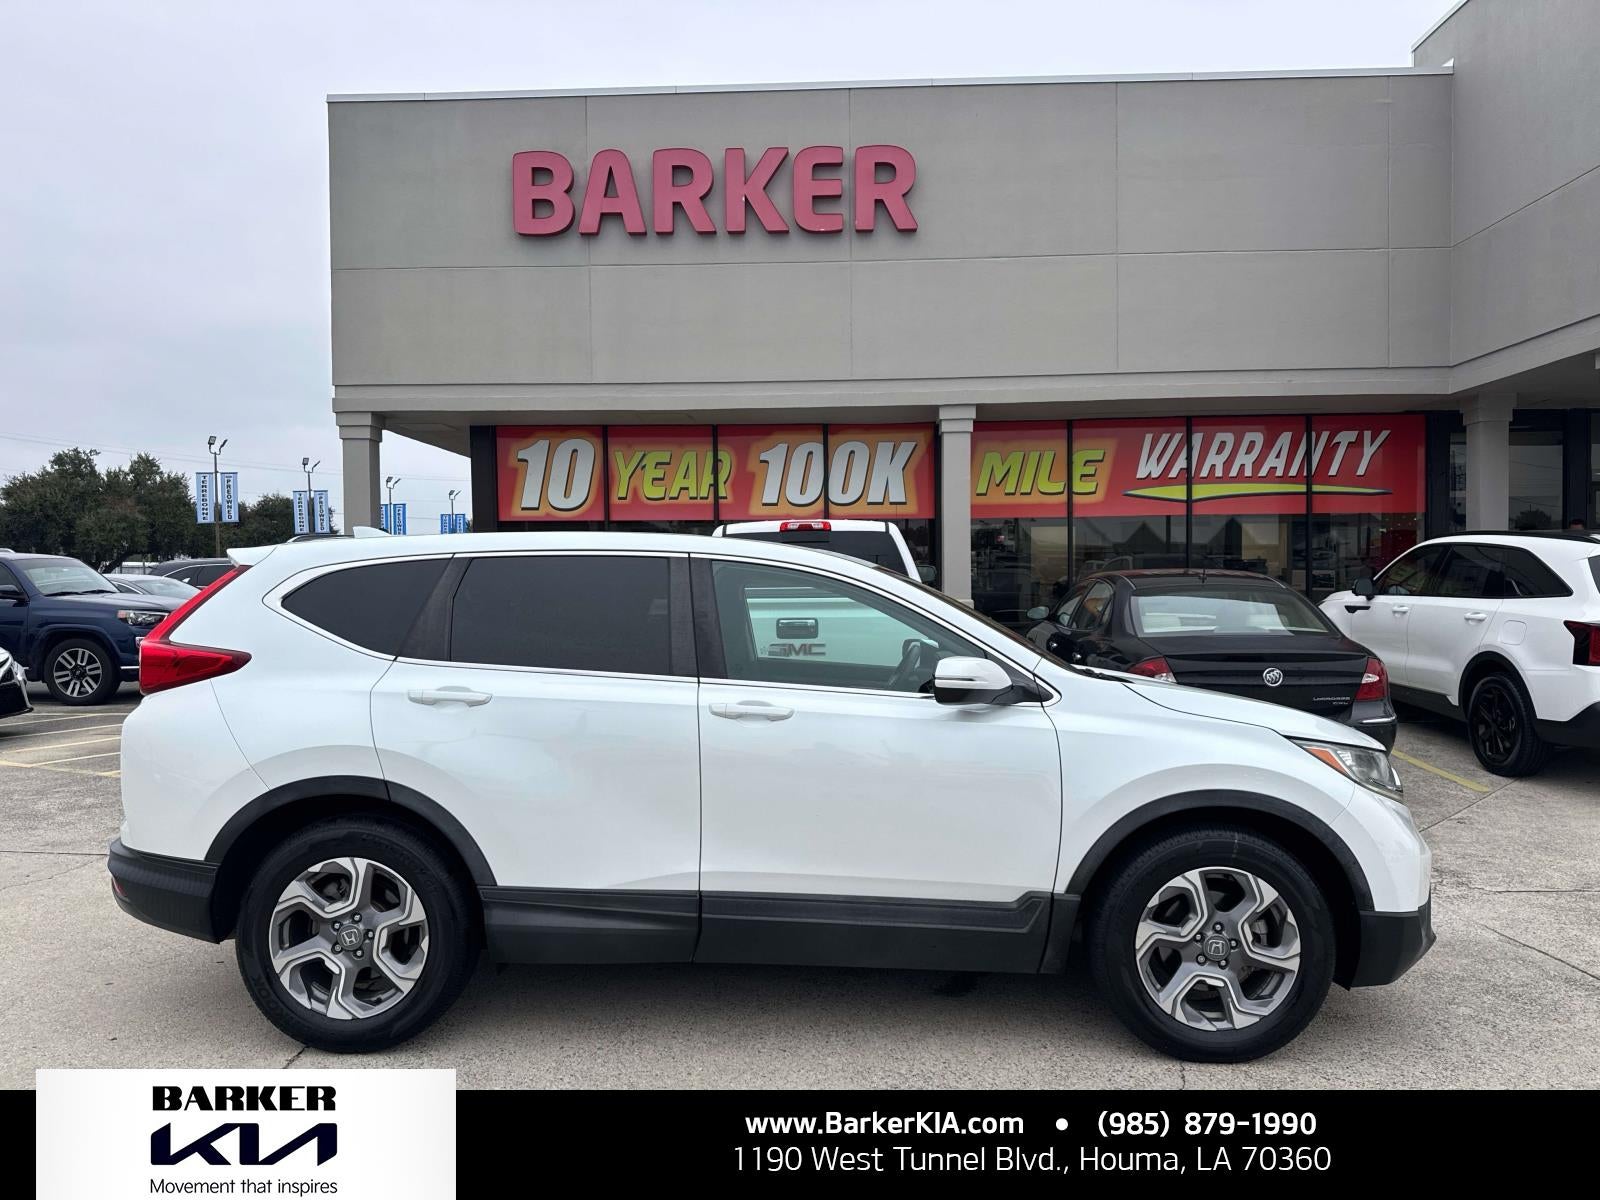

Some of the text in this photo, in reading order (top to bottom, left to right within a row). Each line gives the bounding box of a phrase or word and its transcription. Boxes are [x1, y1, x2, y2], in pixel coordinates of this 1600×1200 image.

[512, 145, 919, 237] BARKER
[516, 429, 1392, 512] 10 YEAR 100K MILE WARRANTY
[767, 642, 827, 658] GMC
